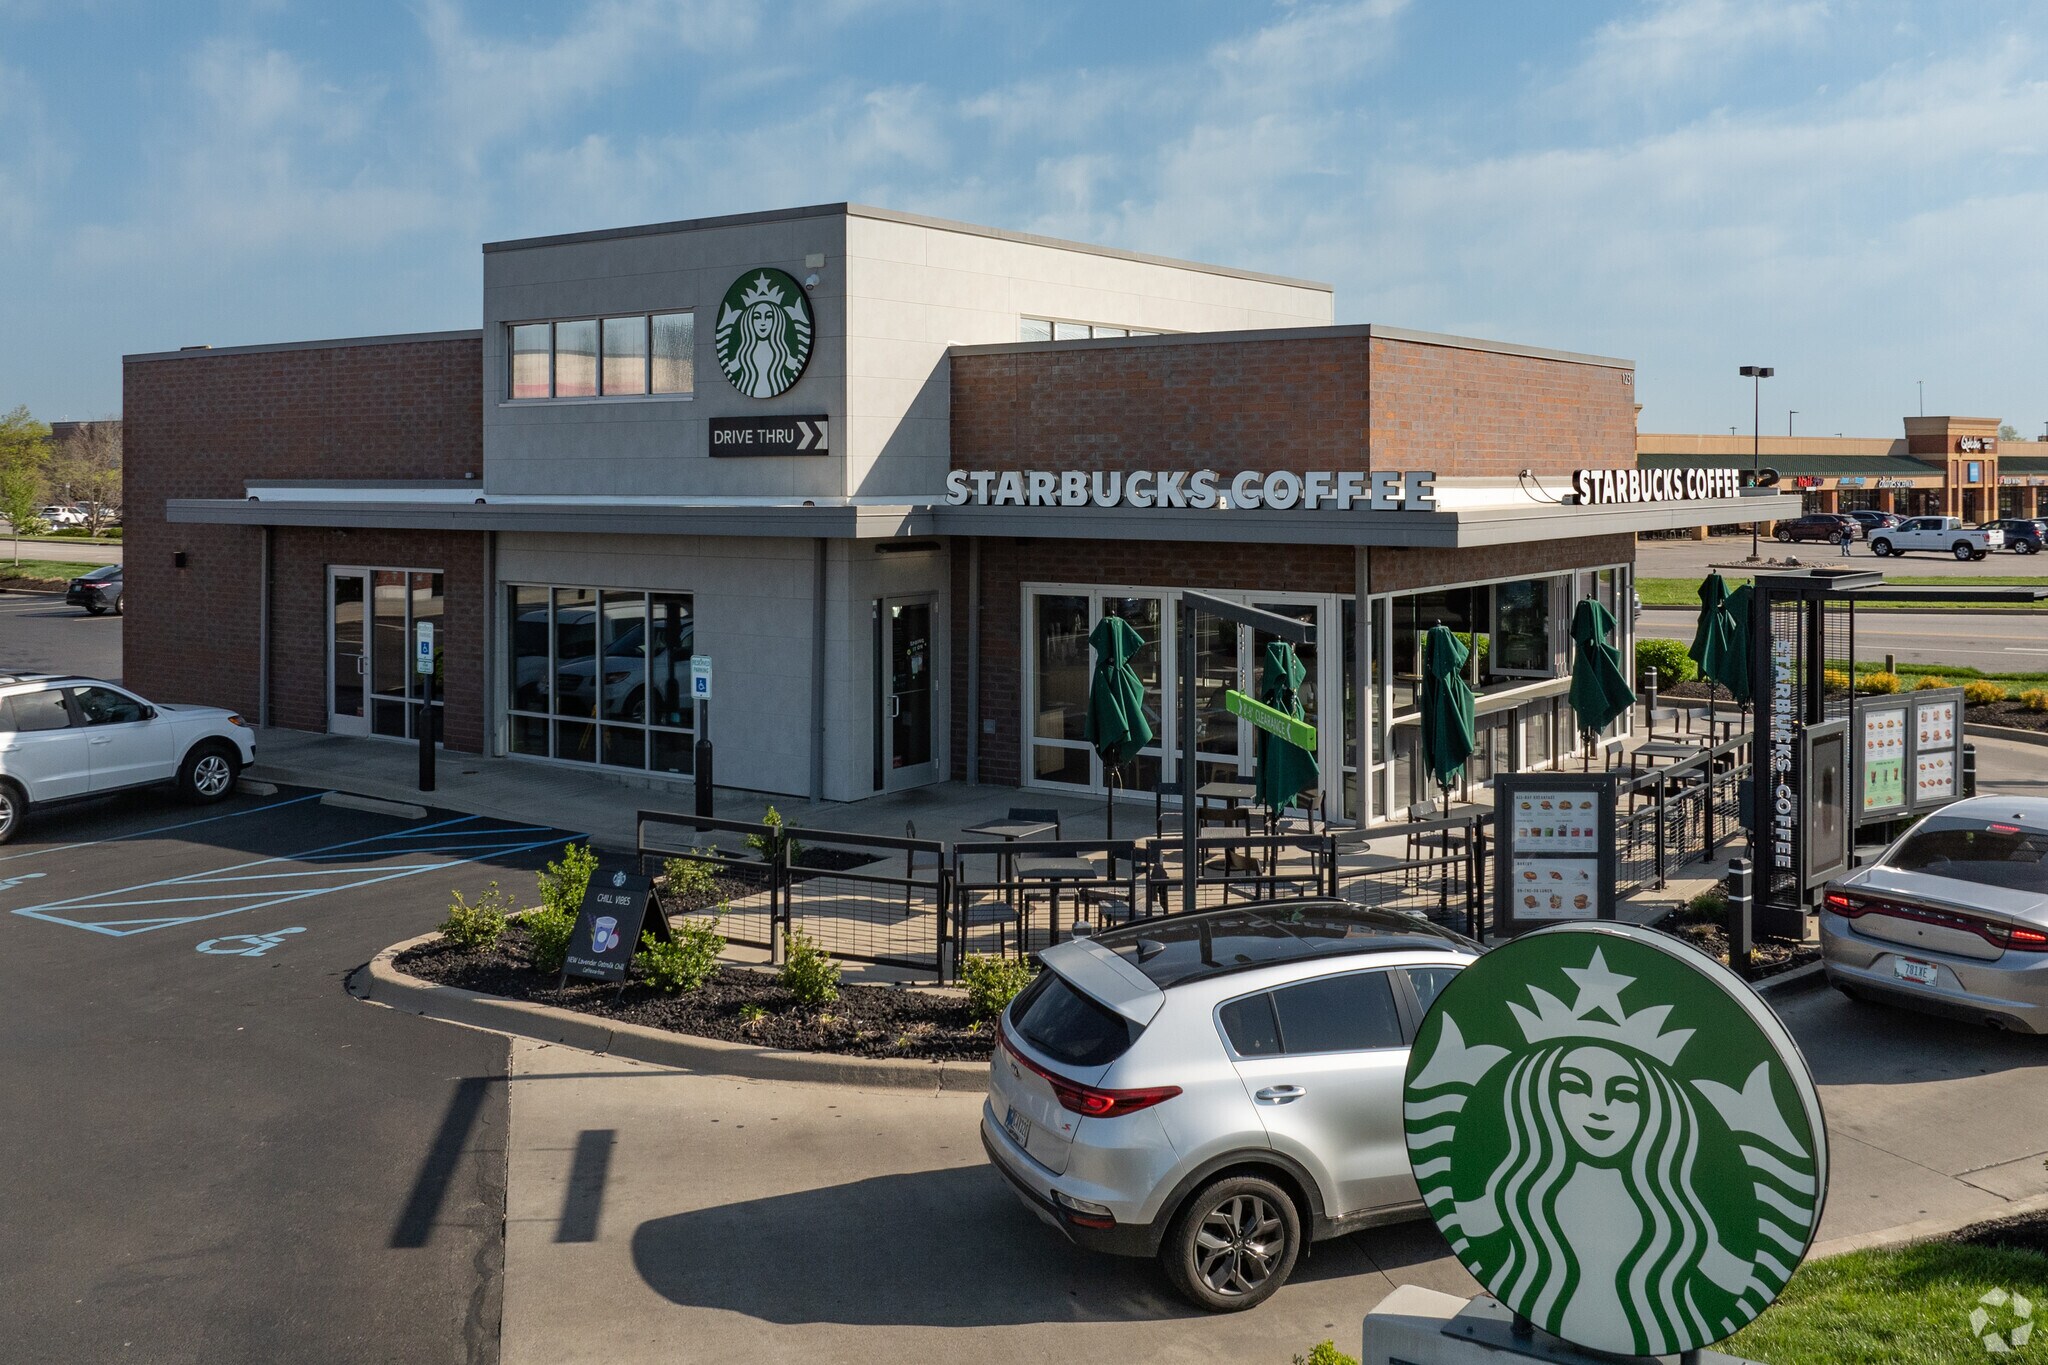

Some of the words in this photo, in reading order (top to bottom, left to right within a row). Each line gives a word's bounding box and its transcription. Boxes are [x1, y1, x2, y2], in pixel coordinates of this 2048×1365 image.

[714, 430, 753, 444] DRIVE
[757, 429, 794, 444] THRU
[945, 470, 1219, 509] STARBUCKS
[1231, 470, 1434, 511] COFFEE
[1578, 468, 1684, 505] STARBUCKS
[1686, 468, 1740, 500] COFFEE
[1775, 639, 1792, 773] STARBUCKS
[1255, 709, 1285, 735] CLEARANCE
[1775, 784, 1792, 869] COFFEE
[597, 893, 613, 904] CHILL
[615, 895, 631, 906] VIBES
[567, 956, 578, 964] NEW
[578, 957, 597, 967] Lavender
